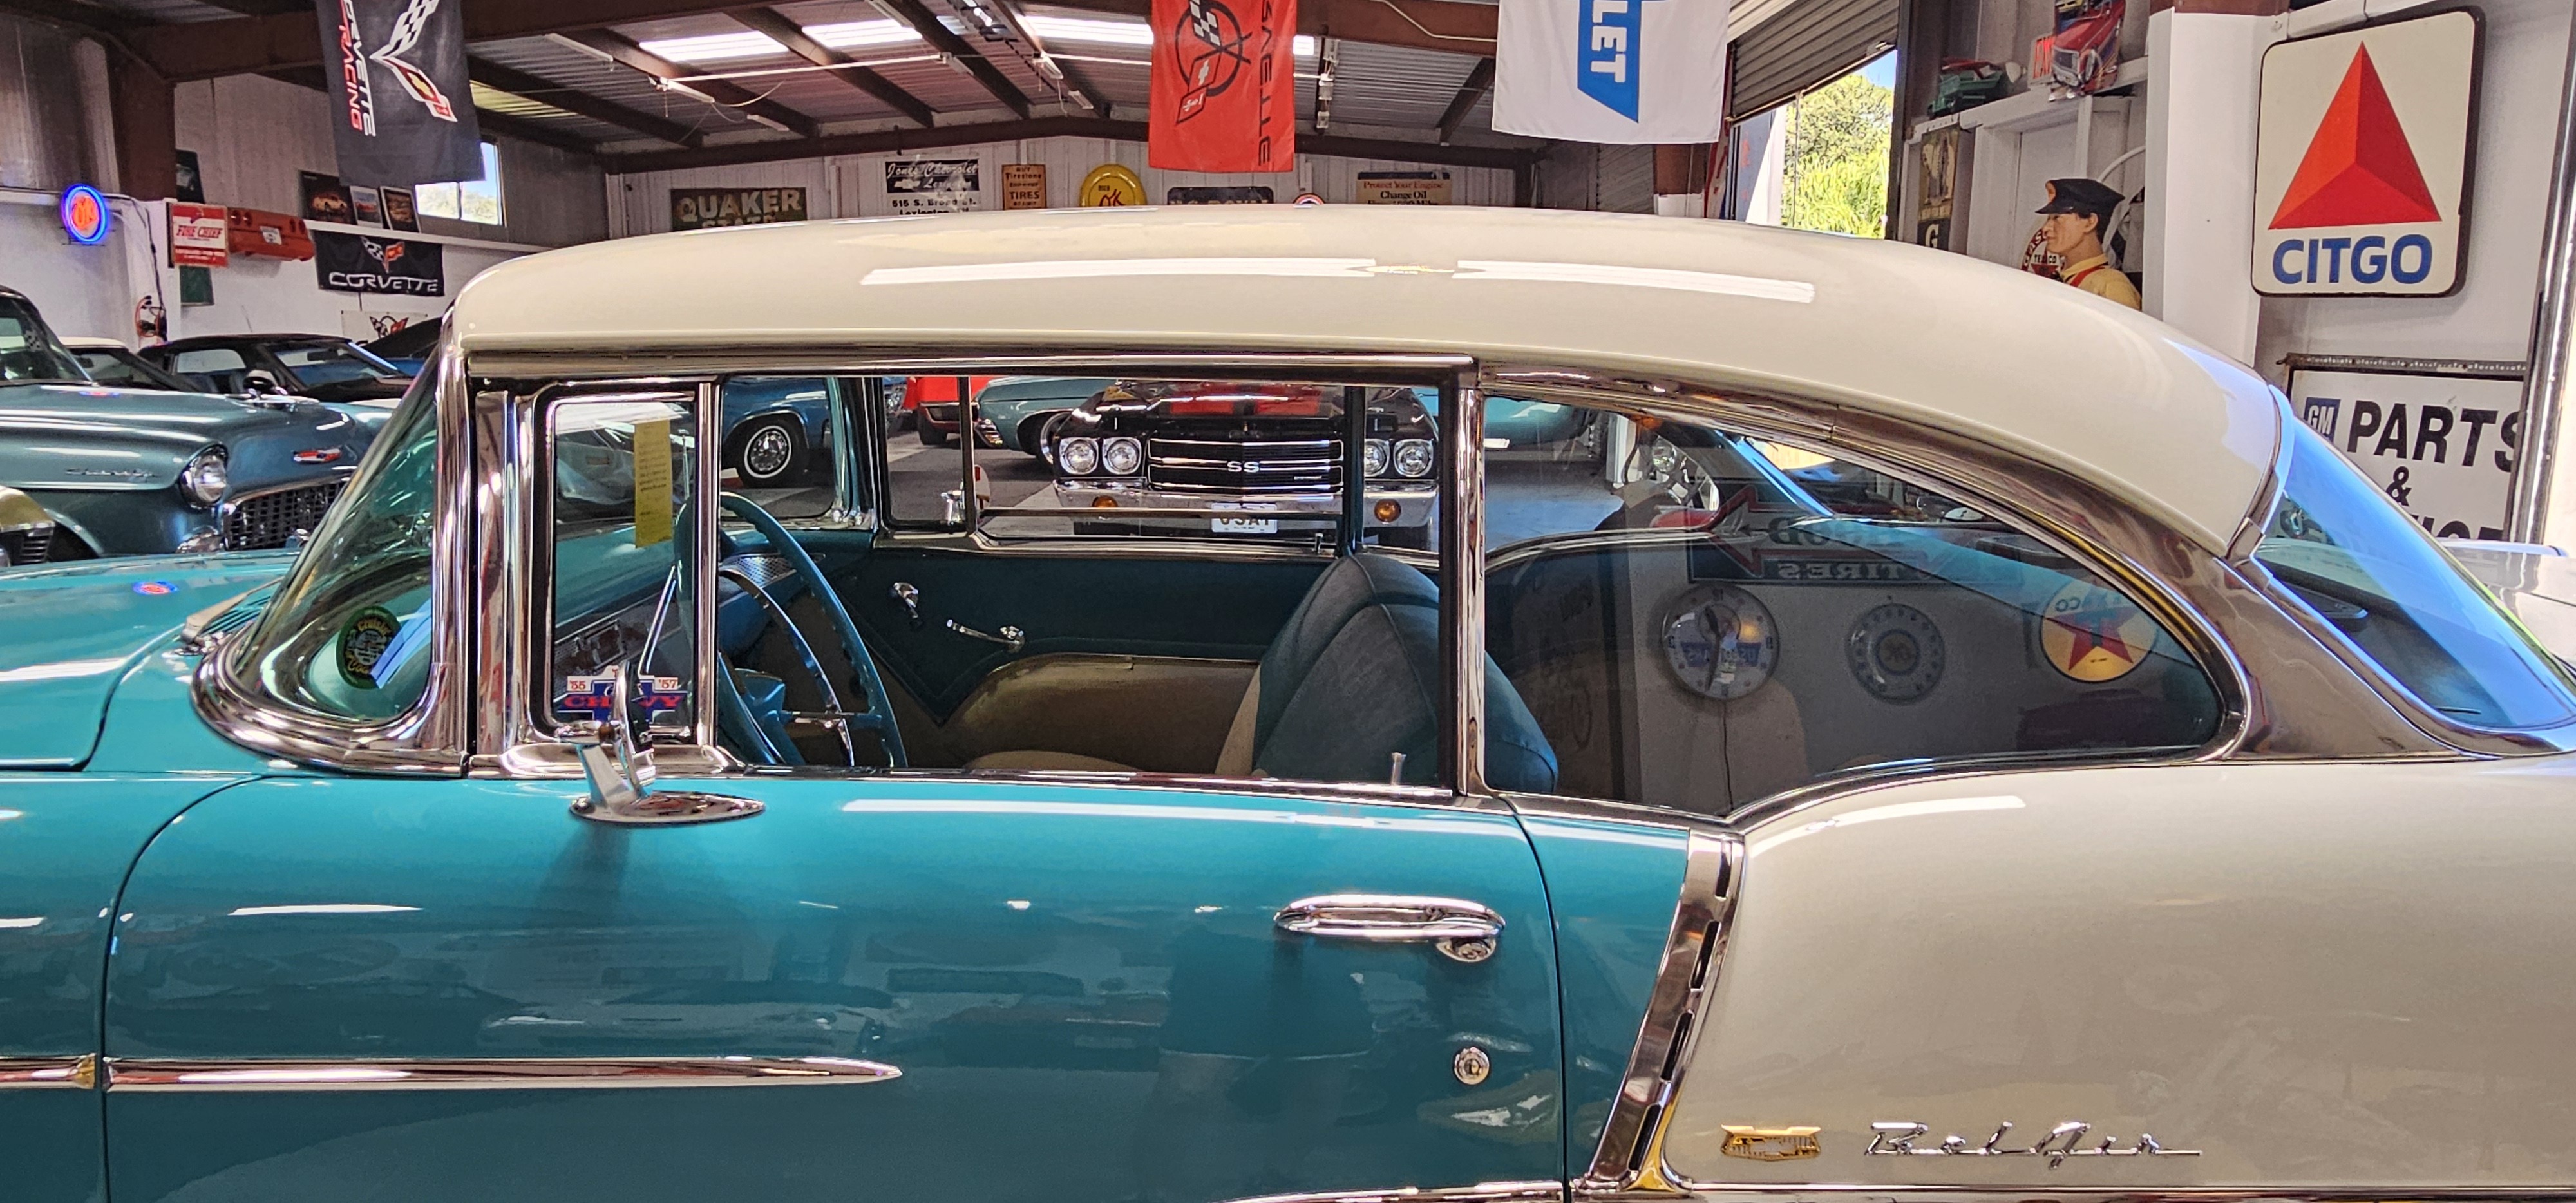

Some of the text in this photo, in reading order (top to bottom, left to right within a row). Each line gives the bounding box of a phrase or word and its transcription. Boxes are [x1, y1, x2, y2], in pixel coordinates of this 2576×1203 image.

[1591, 0, 1628, 82] LET
[339, 24, 363, 131] RACING
[887, 162, 978, 179] Jones Chevrolet
[1009, 191, 1039, 200] TIRES
[1380, 191, 1427, 200] Change Oil
[677, 189, 802, 223] QUAKER
[198, 226, 223, 238] CHIEF
[2272, 234, 2433, 285] CITGO
[328, 271, 439, 292] CORVETTE
[2306, 400, 2521, 473] GM PARTS
[1227, 460, 1260, 473] SS
[2385, 466, 2412, 507] &
[569, 679, 586, 690] '55
[658, 679, 677, 688] '57
[564, 695, 685, 708] CHVY
[1864, 1121, 2202, 1170] Bel Air
